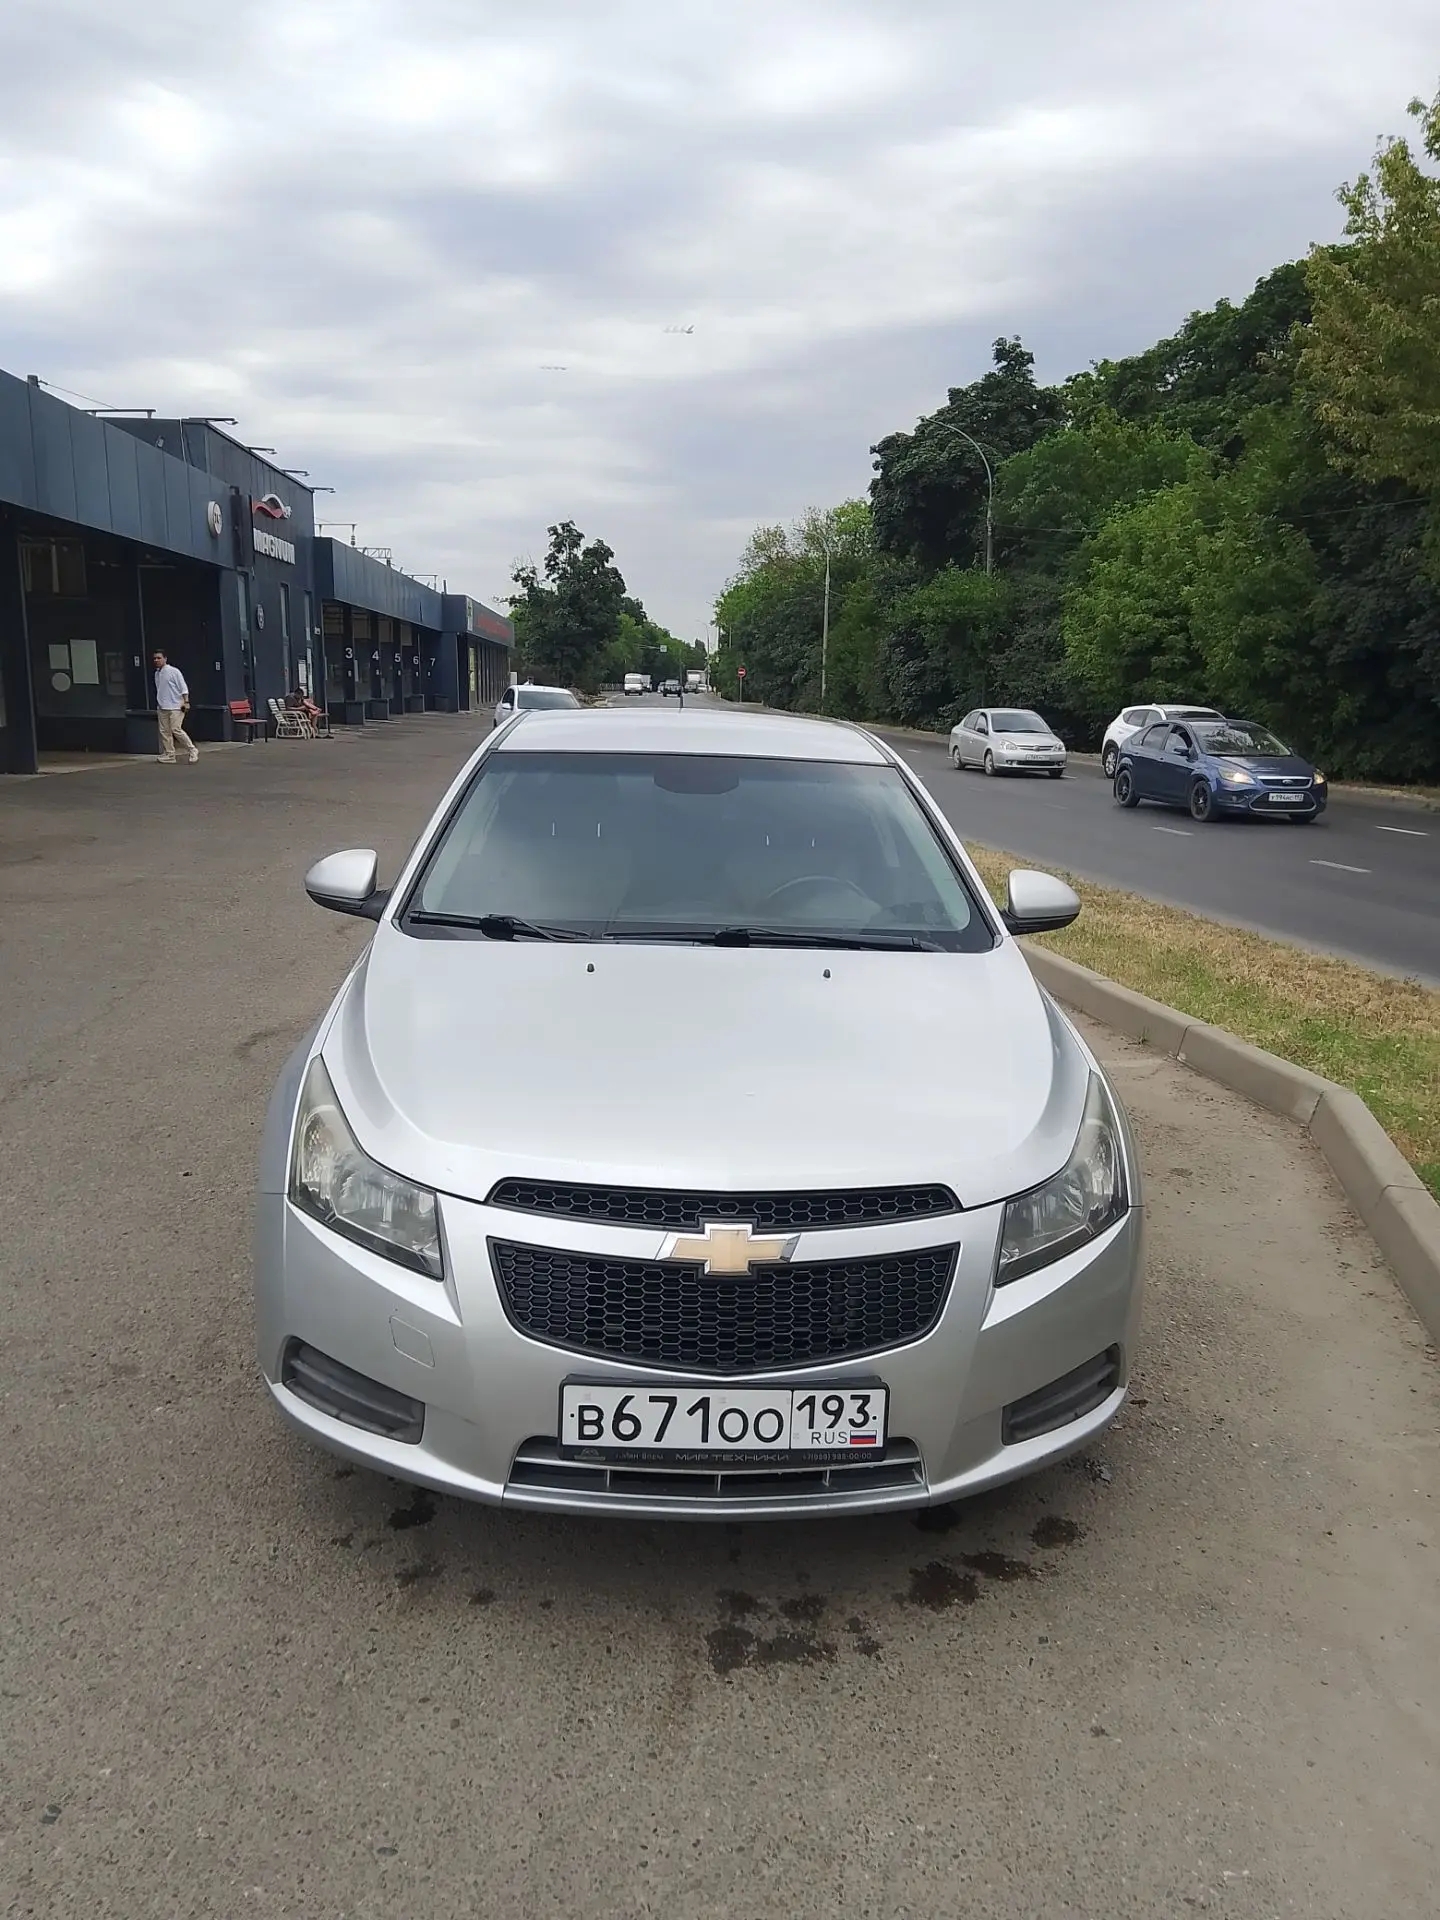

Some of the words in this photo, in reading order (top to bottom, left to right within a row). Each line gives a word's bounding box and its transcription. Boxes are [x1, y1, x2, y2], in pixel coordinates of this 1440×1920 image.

[253, 527, 296, 566] MAGNUM
[345, 647, 353, 660] 3
[372, 650, 380, 661] 4
[394, 653, 401, 663] 5
[412, 655, 420, 665] 6
[430, 657, 437, 667] 7
[577, 1394, 784, 1443] В671ОО
[795, 1394, 872, 1430] 193
[810, 1431, 848, 1444] RUS
[675, 1453, 709, 1461] МИР
[711, 1453, 790, 1462] ТЕХНИКИ
